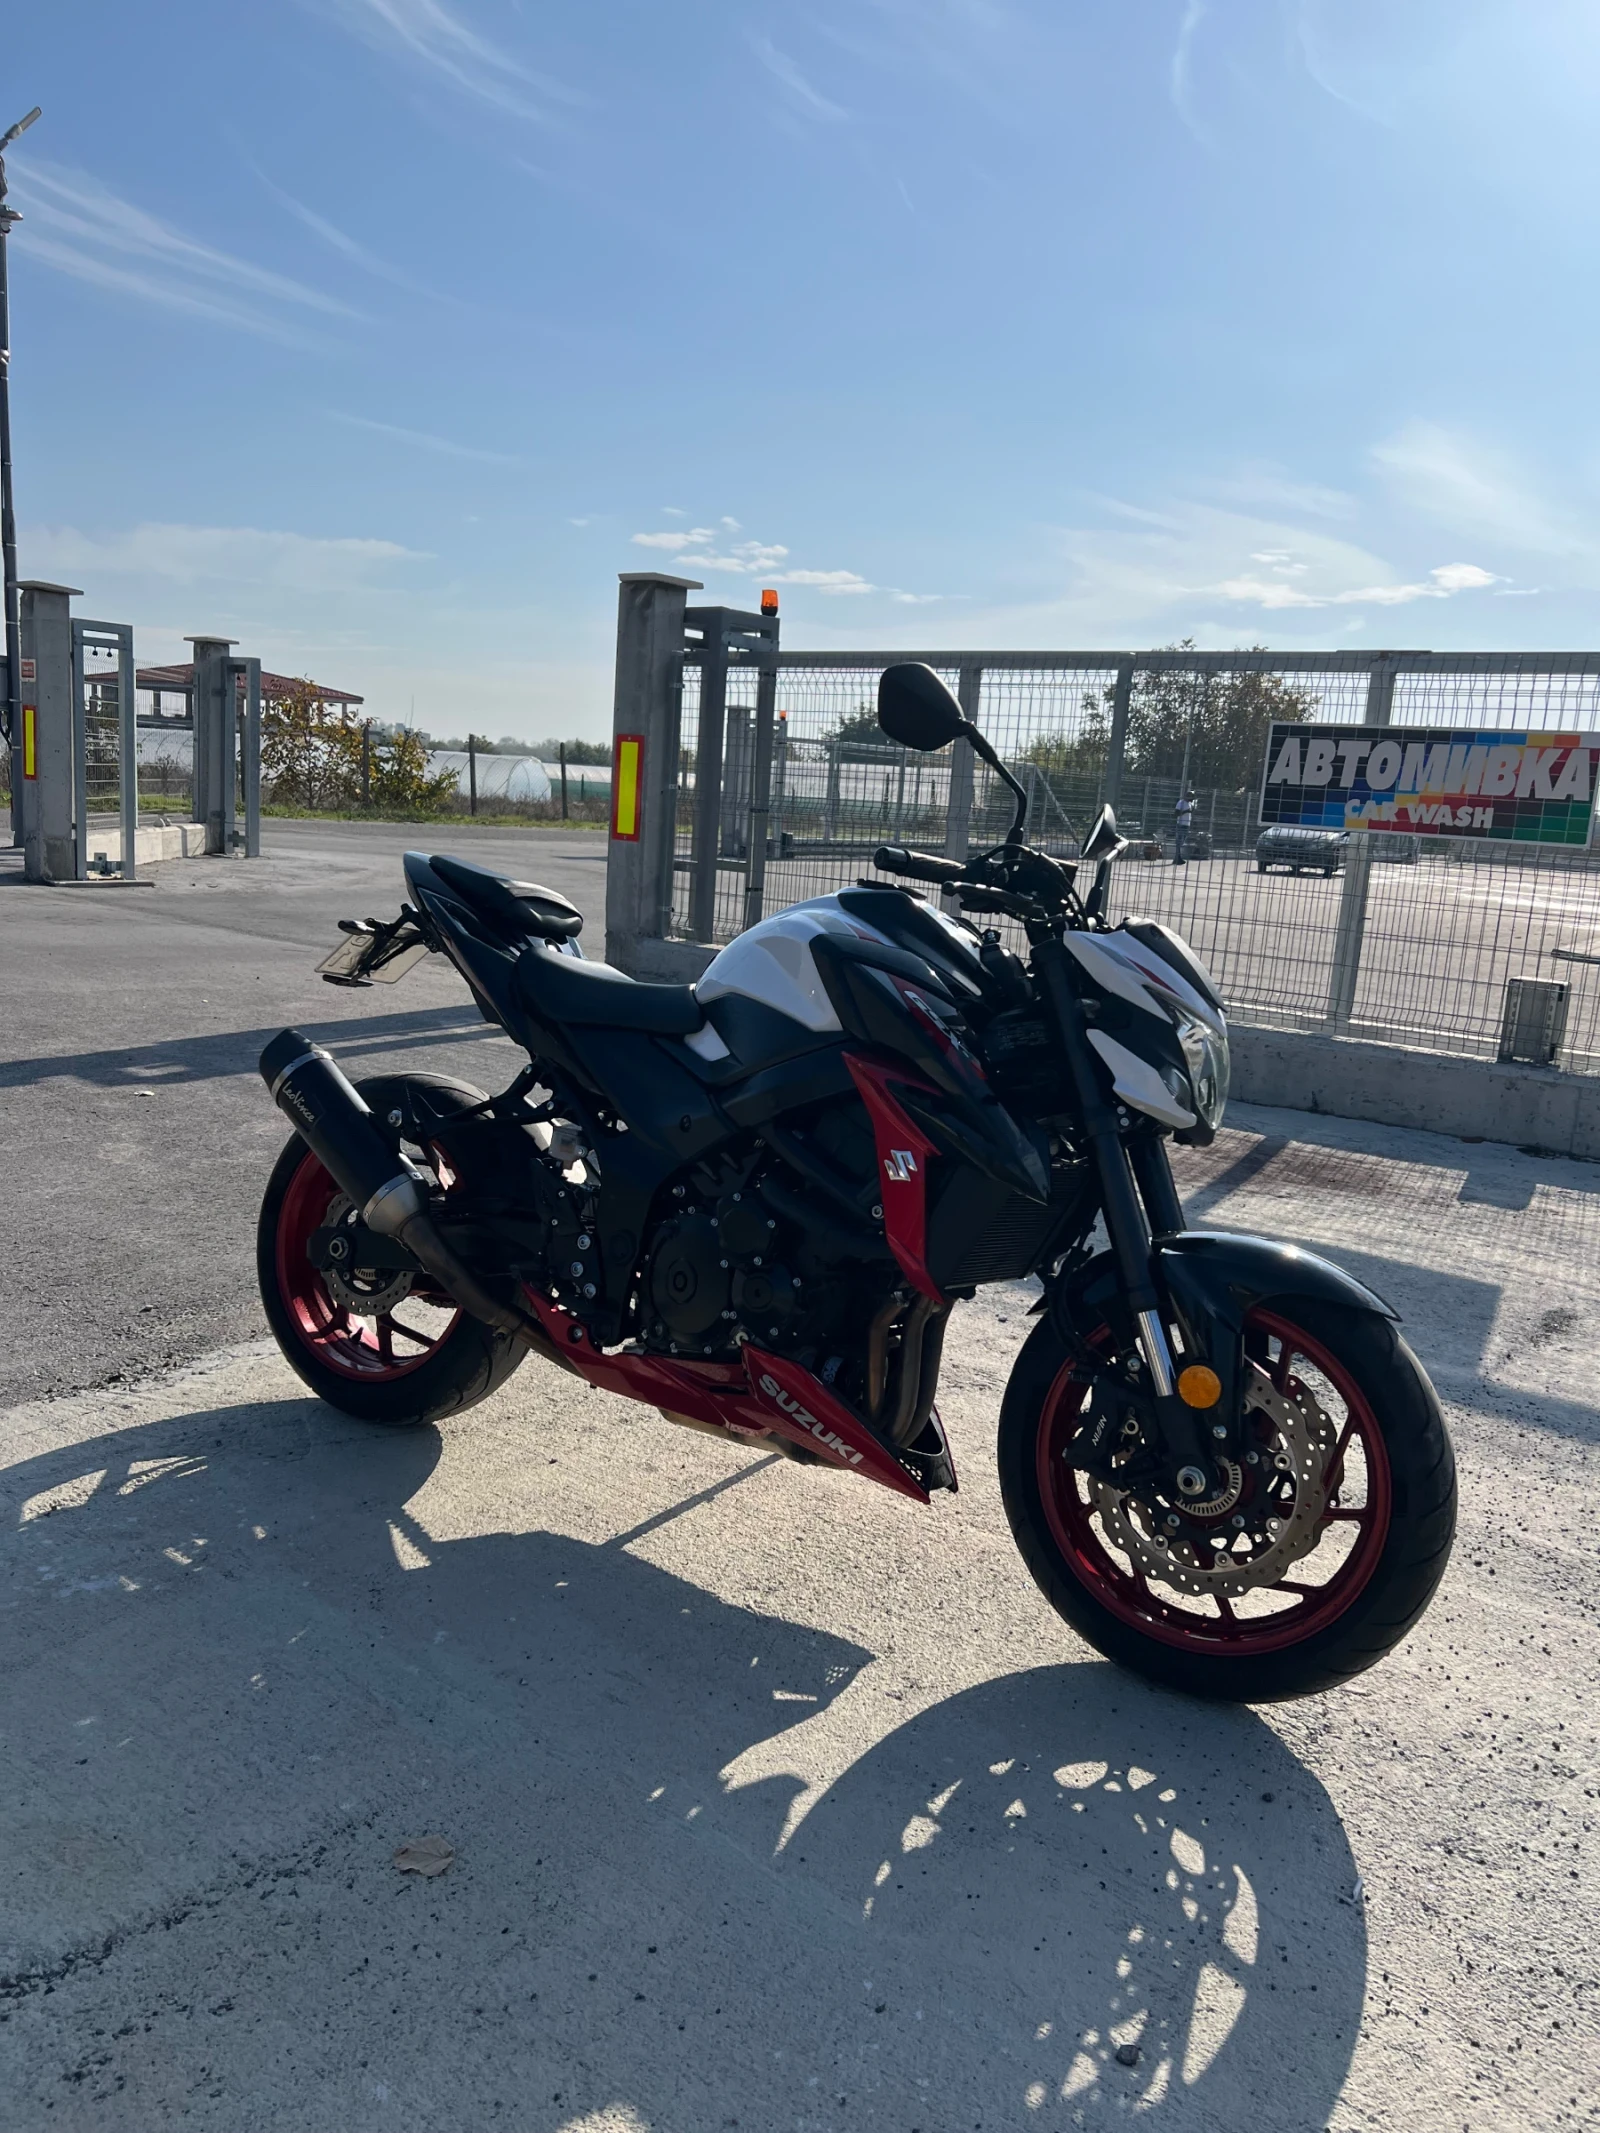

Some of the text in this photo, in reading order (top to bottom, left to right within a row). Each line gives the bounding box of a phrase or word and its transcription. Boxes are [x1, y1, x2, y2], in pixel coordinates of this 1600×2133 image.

[1268, 738, 1590, 801] АВТОМИВКА
[1344, 799, 1494, 829] CAR WASH
[759, 1374, 864, 1464] SUZUKI
